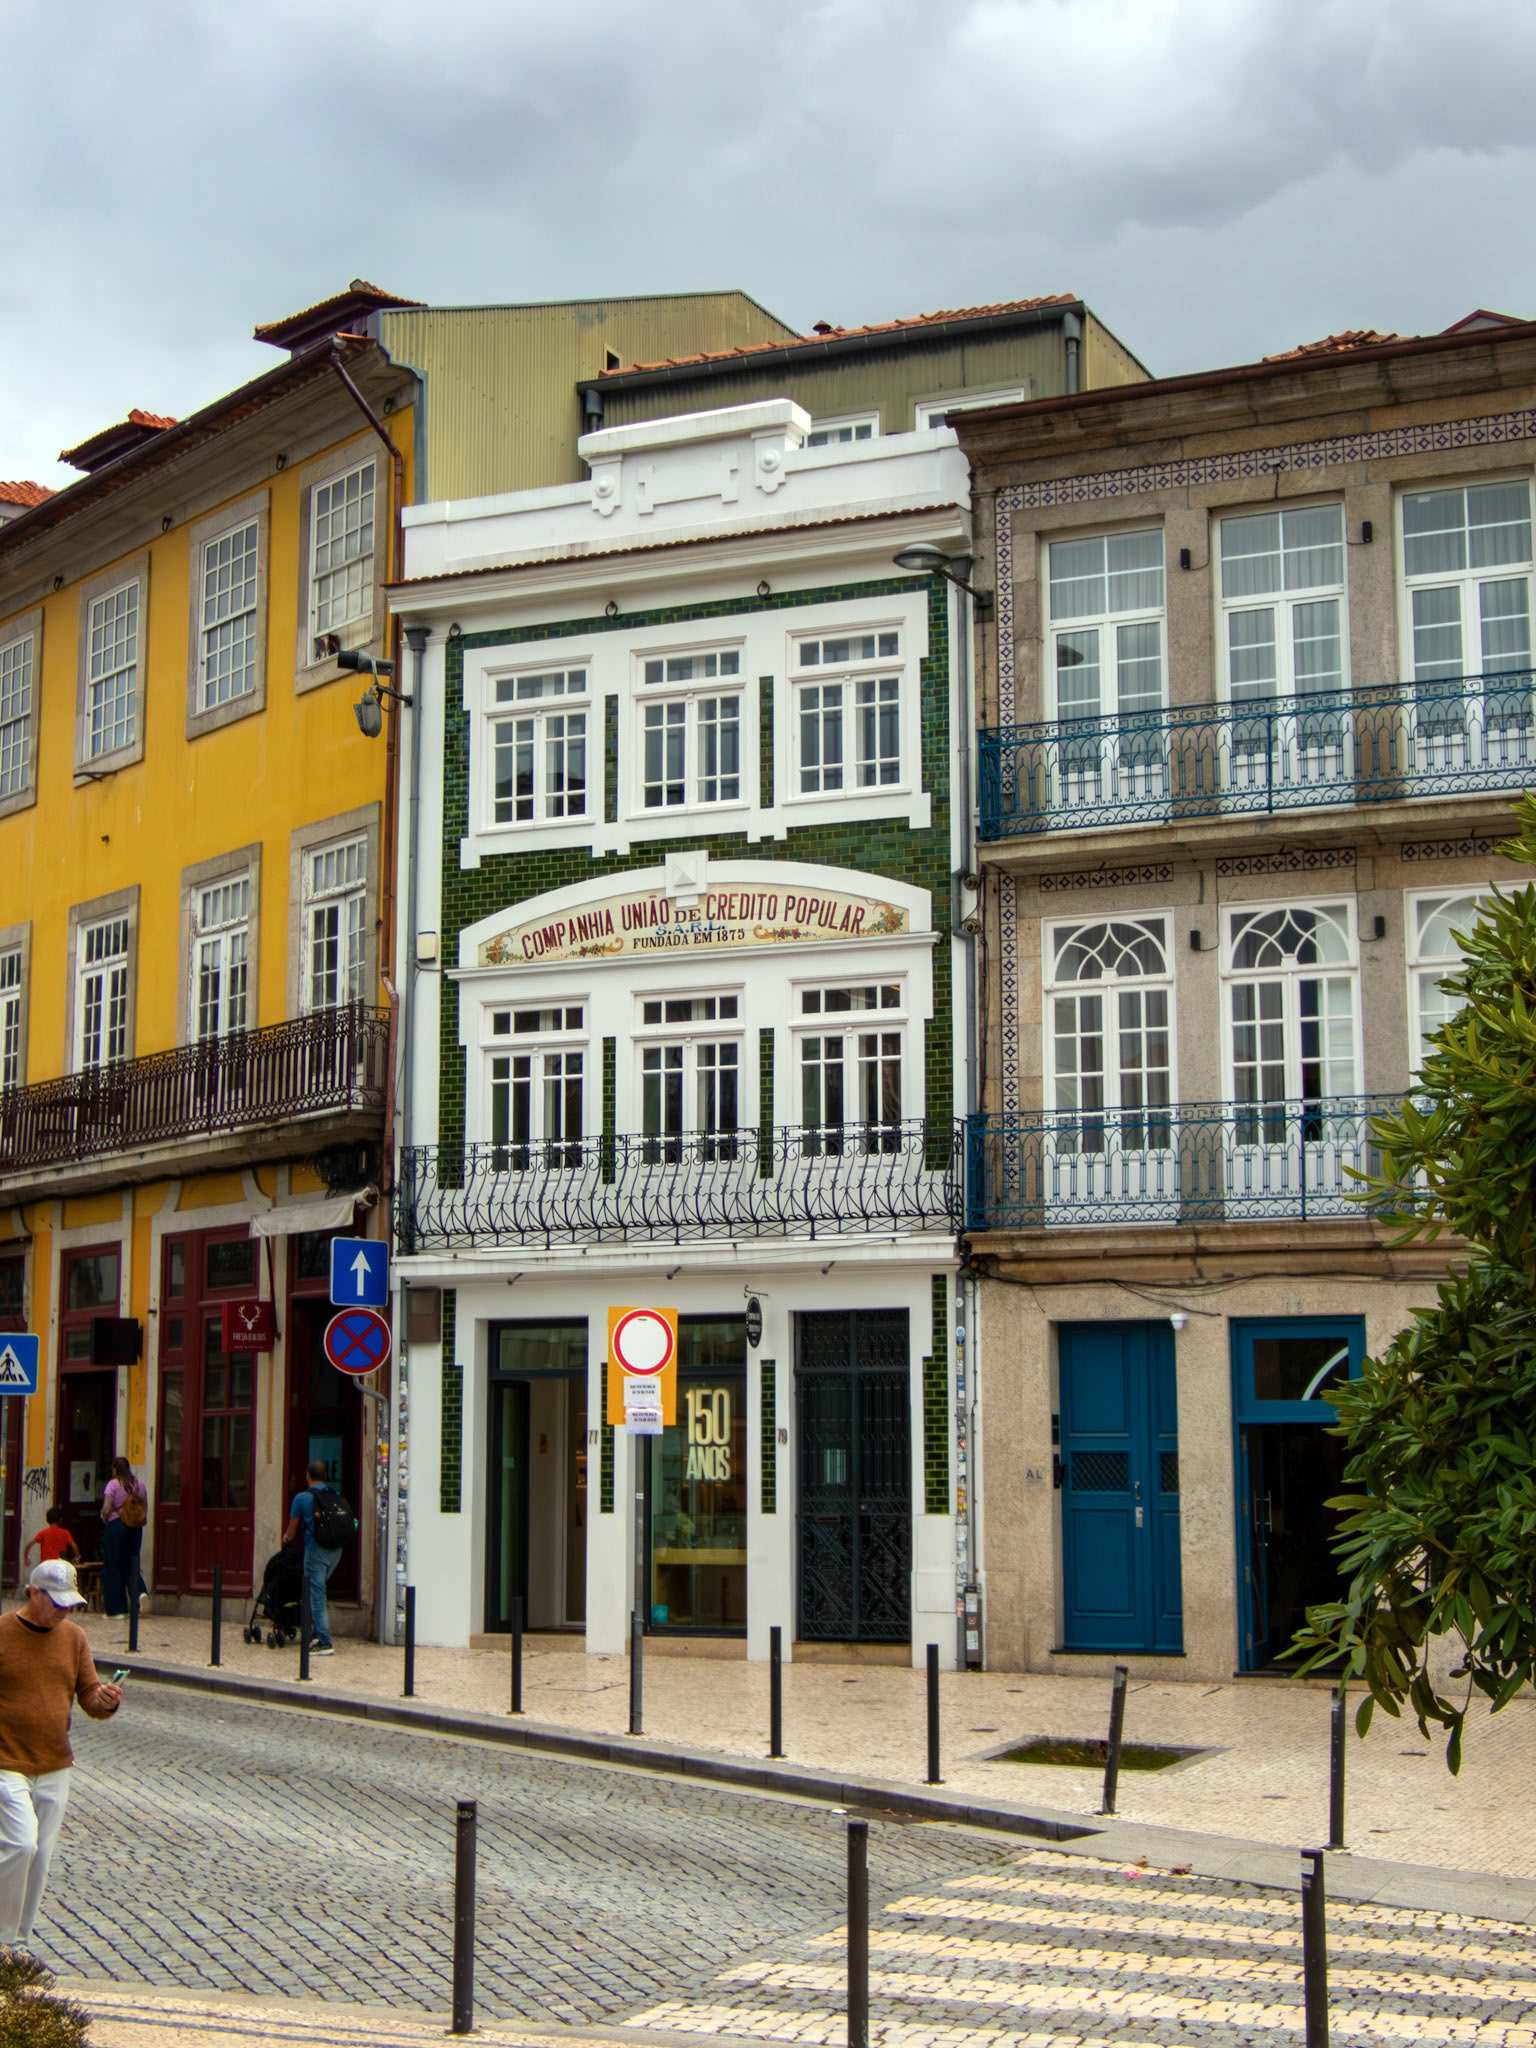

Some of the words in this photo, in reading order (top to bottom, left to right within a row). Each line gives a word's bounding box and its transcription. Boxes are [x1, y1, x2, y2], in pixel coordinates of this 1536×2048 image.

[521, 908, 615, 960] COMPANHIA
[621, 894, 670, 931] UNIÃO
[674, 908, 702, 924] DE
[705, 893, 778, 922] CREDITO
[783, 895, 865, 935] POPULAR
[655, 920, 726, 936] S.A.R.L.
[633, 932, 689, 949] FUNDADA
[693, 931, 712, 945] EM
[716, 928, 746, 942] 1875
[685, 1388, 731, 1446] 150
[587, 1429, 599, 1445] 77
[777, 1428, 788, 1445] 79
[685, 1446, 731, 1481] ANOS
